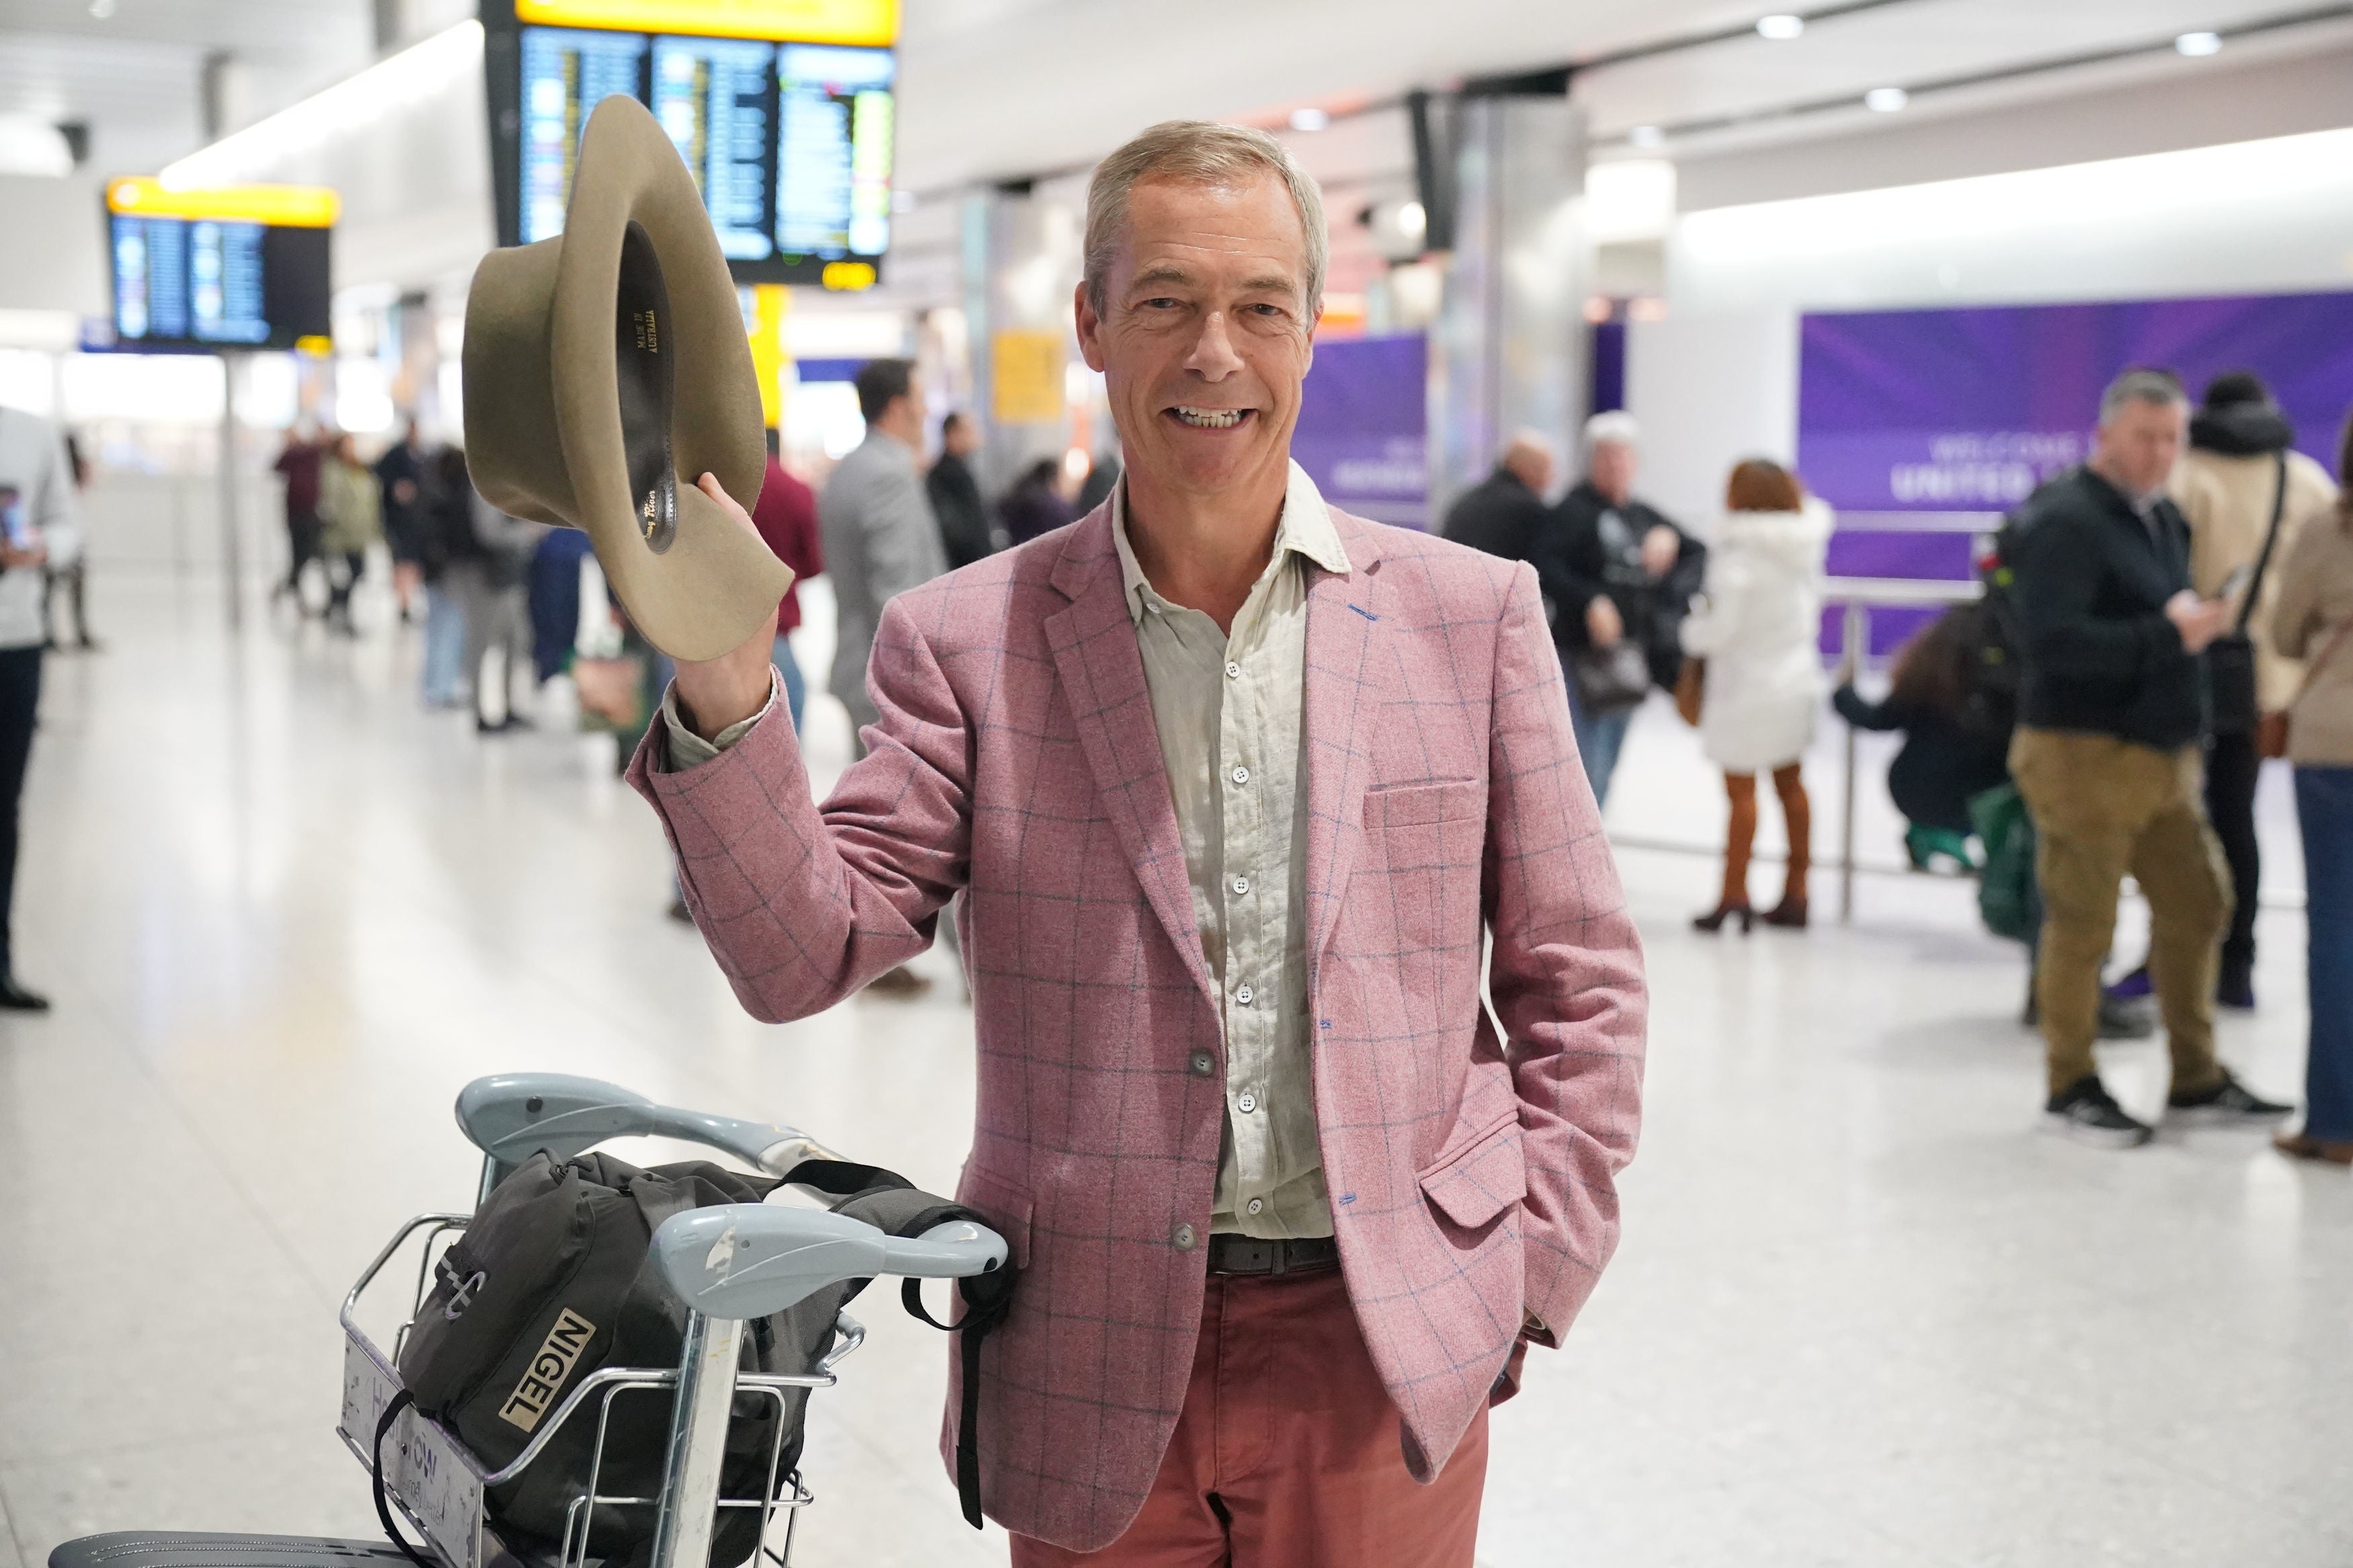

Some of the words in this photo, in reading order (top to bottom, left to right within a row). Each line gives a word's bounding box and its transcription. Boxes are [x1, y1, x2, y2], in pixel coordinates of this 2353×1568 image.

[635, 325, 646, 349] MADE
[645, 310, 657, 354] AUSTRALIA
[1890, 462, 2036, 503] UNITED
[643, 490, 656, 518] River
[506, 1315, 589, 1415] NIGEL
